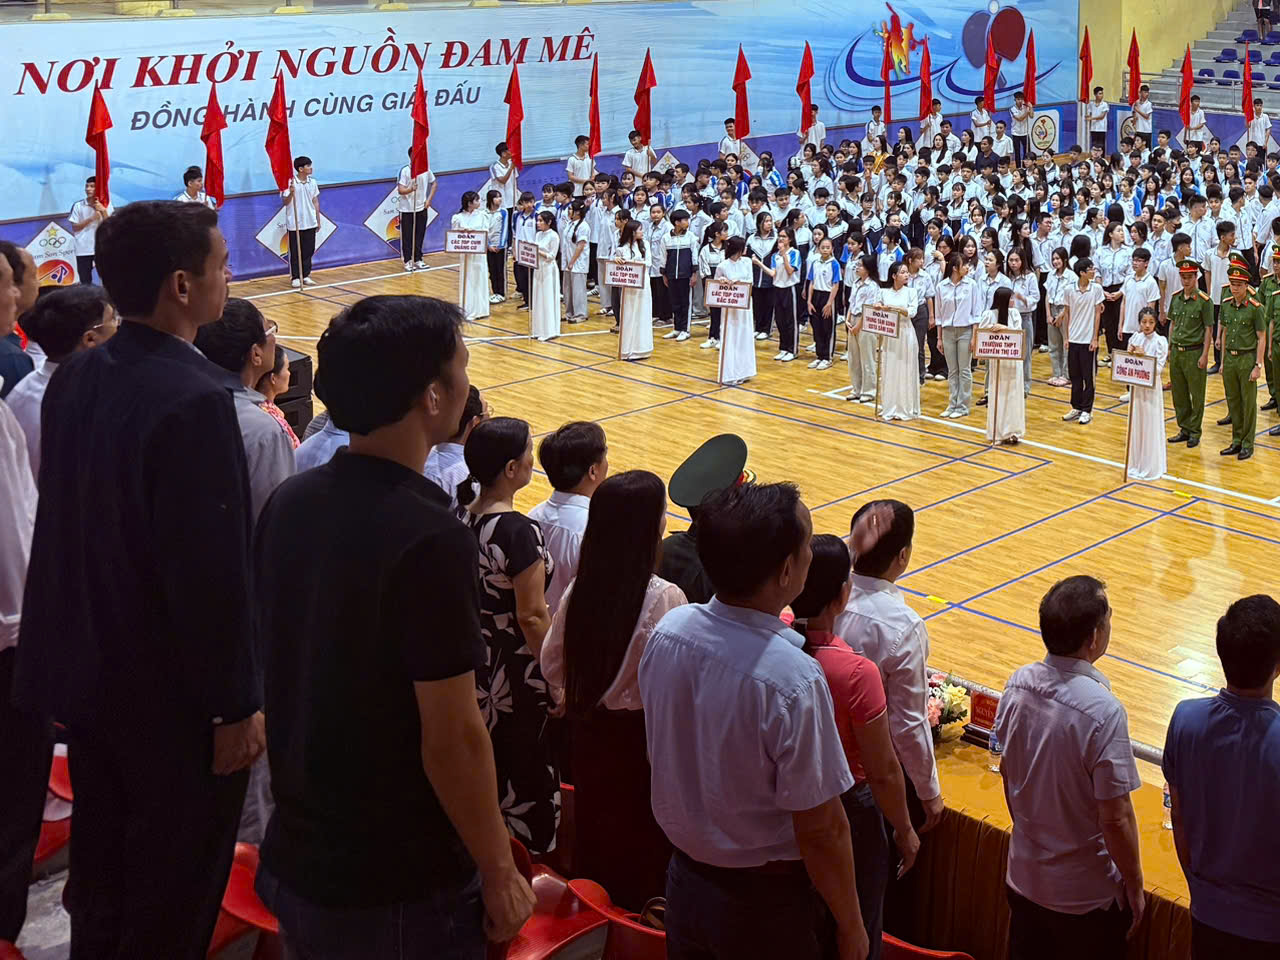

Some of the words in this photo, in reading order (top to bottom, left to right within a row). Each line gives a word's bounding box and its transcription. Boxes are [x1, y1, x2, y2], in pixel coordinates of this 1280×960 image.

[13, 57, 121, 95] NƠI
[130, 40, 262, 88] KHỞI
[272, 27, 432, 80] NGUỒN
[439, 36, 531, 69] ĐAM
[539, 26, 595, 63] MÊ
[303, 92, 373, 117] CÙNG
[434, 79, 481, 107] ĐẤU
